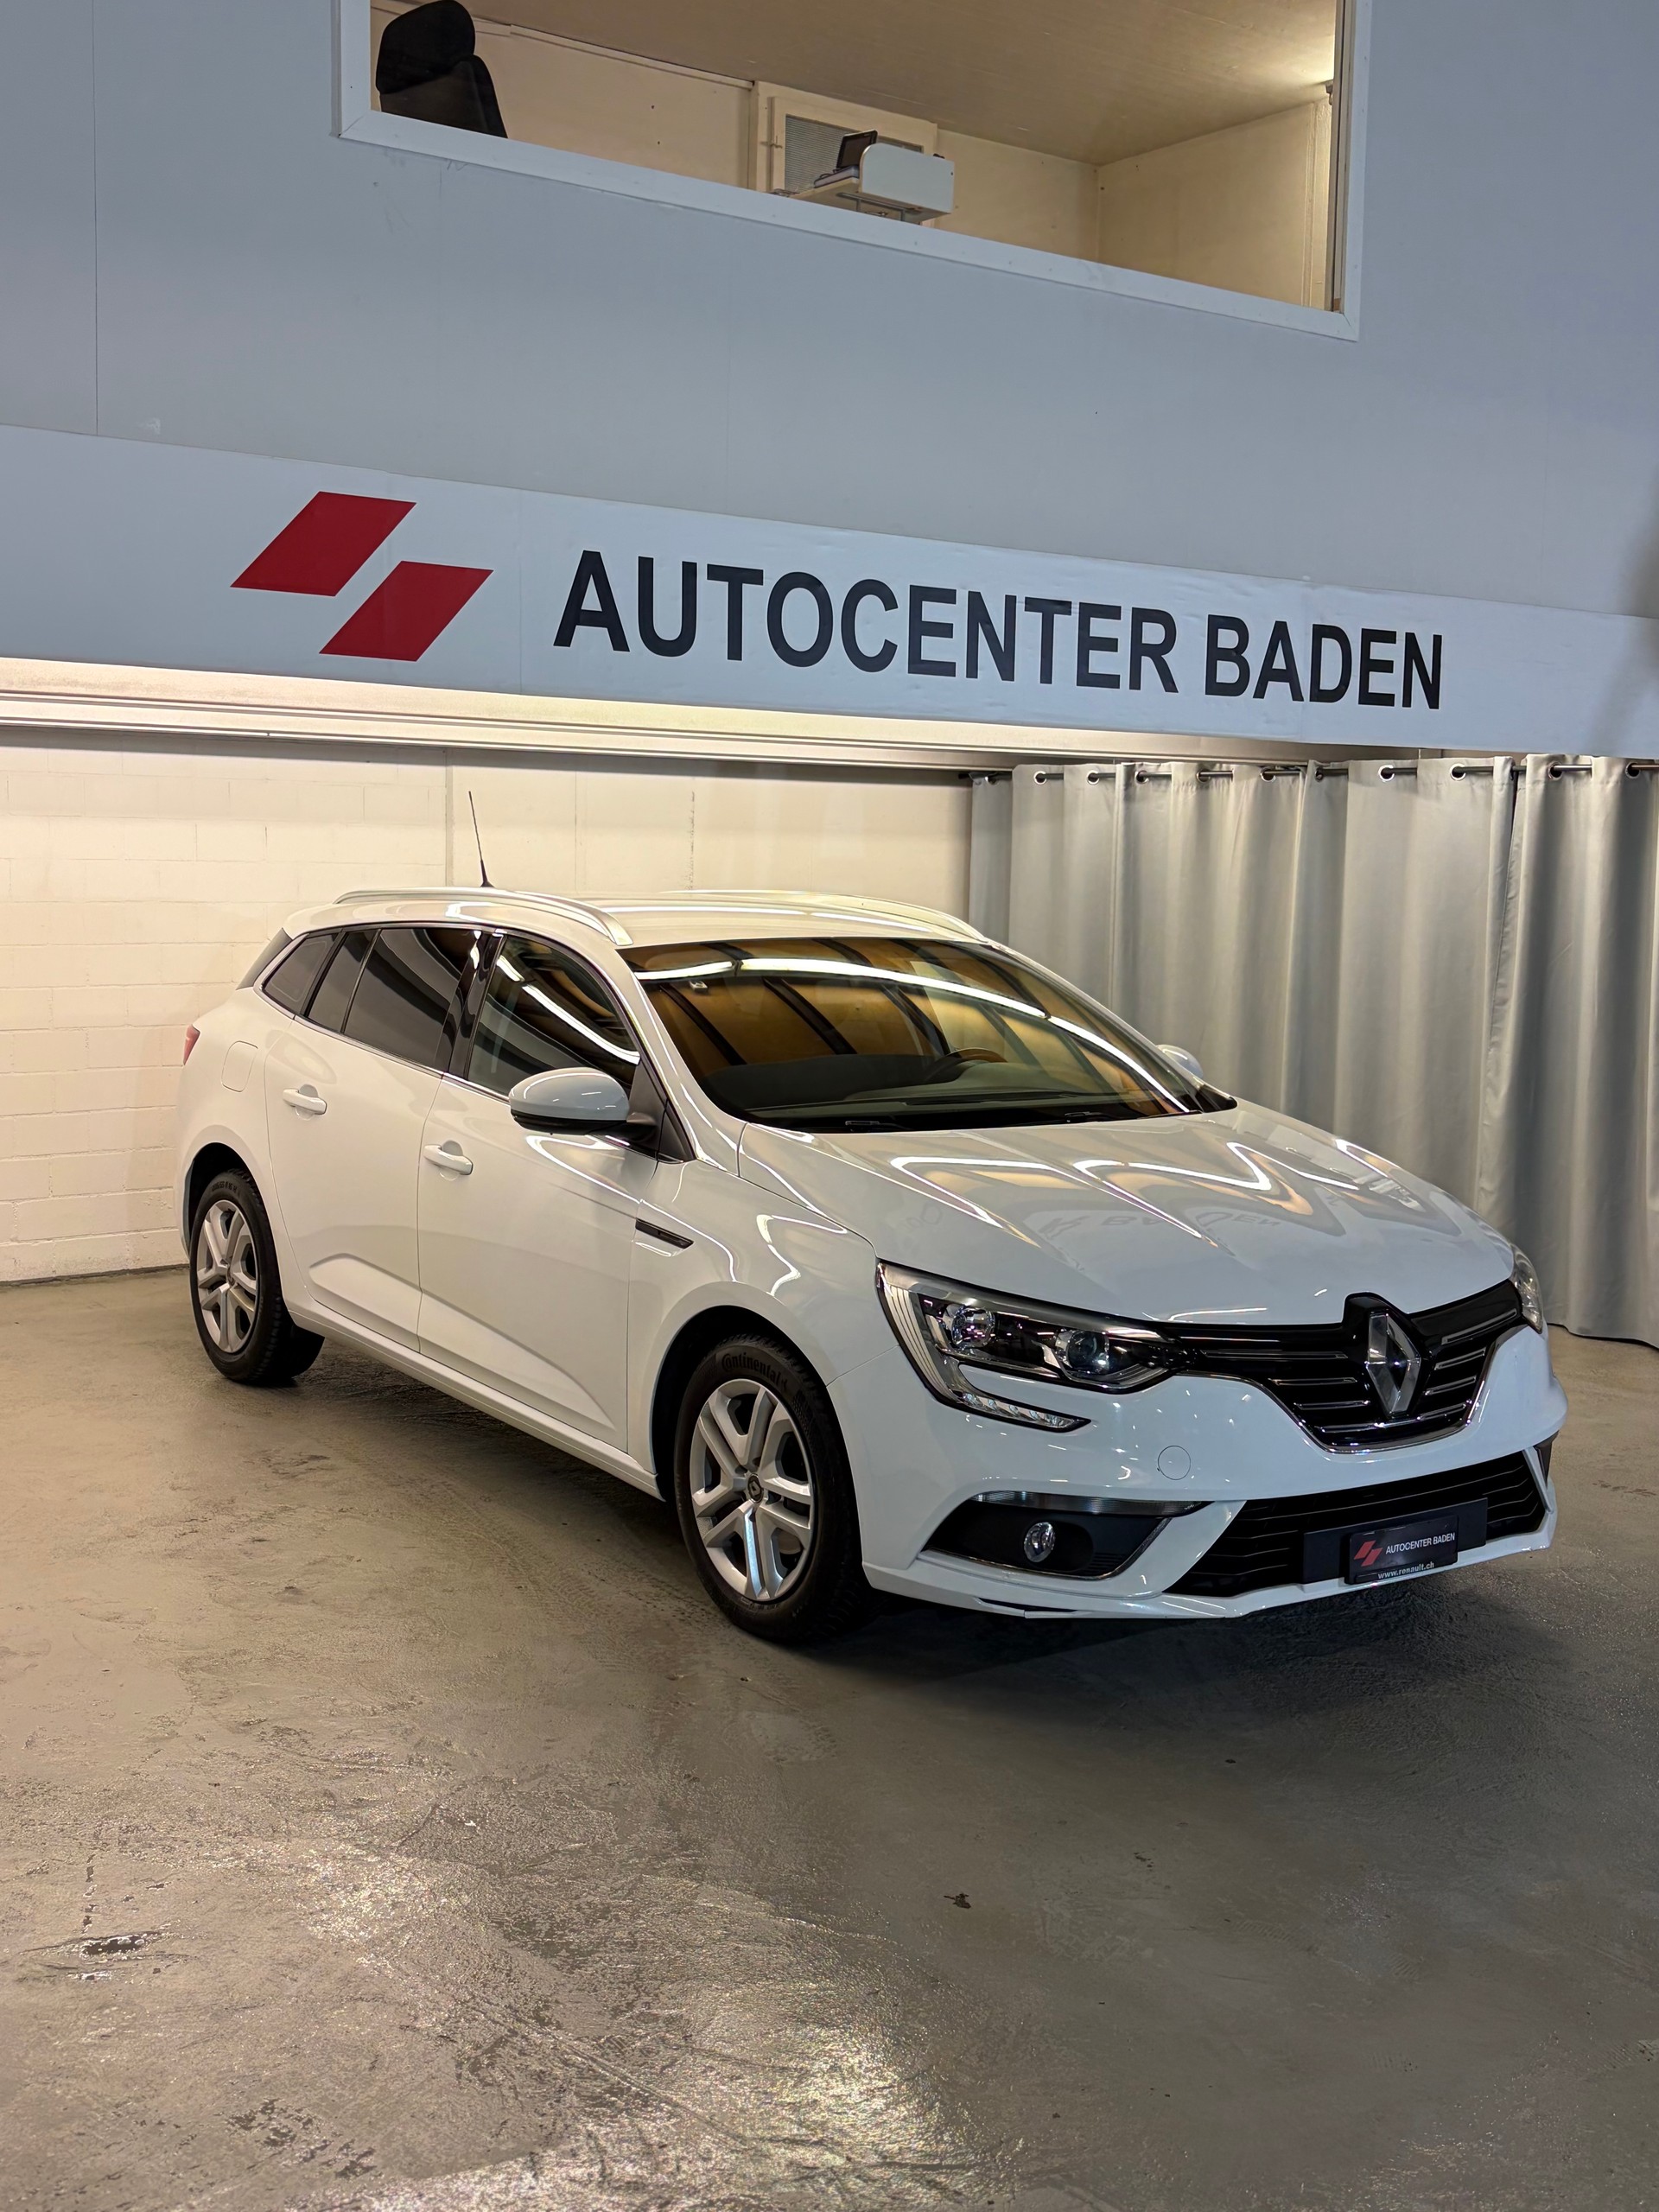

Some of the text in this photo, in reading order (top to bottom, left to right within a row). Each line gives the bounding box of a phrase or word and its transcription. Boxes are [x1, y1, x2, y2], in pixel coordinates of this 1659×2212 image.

[554, 550, 1443, 710] AUTOCENTER BADEN
[721, 1351, 781, 1385] Continental
[1385, 1532, 1455, 1554] AUTOCENTER BADEN
[1377, 1560, 1434, 1580] www.renault.ch
